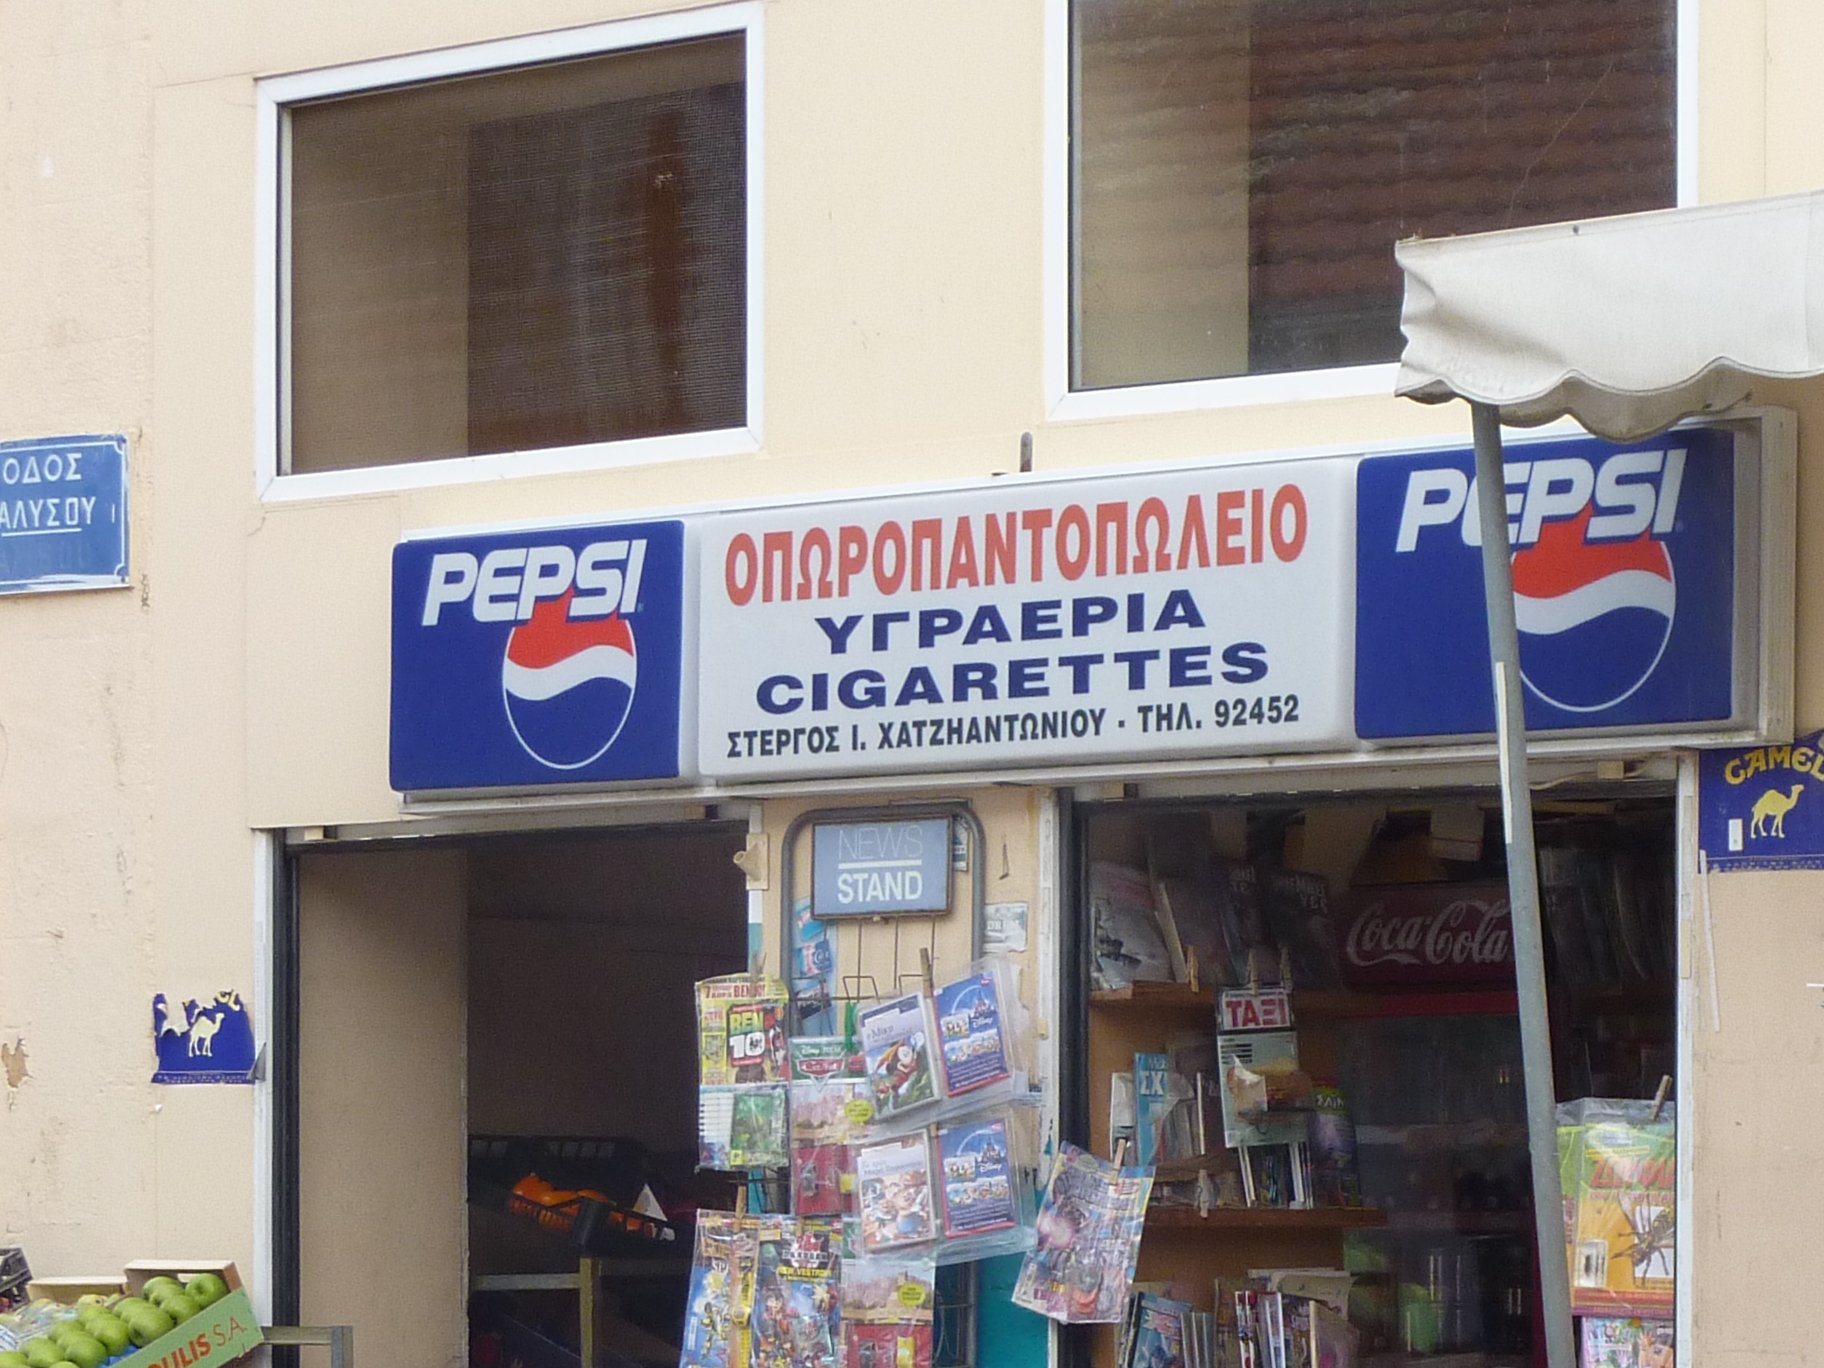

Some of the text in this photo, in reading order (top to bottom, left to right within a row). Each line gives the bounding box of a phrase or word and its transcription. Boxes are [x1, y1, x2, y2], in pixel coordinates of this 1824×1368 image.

[3, 452, 82, 485] ΟΔΟΣ
[1396, 448, 1687, 553] PEPSI
[725, 483, 1308, 606] ΟΠΩΡΟΠΑΝΤΟΠΩΛΕΙΟ
[422, 539, 647, 625] PEPSI
[815, 588, 1205, 654] ΥΓΡΑΕΡΙΑ
[757, 641, 1268, 715] CIGARETTES
[727, 725, 840, 757] ΣΤΕΡΓΟΣ
[878, 708, 1106, 749] ΧΑΤΖΗΑΝΤΩΝΙΟΥ
[1138, 701, 1202, 734] ΤΗΛ.
[1215, 694, 1299, 727] 92452
[838, 826, 923, 860] NEWS
[838, 871, 923, 903] STAND
[1348, 899, 1512, 967] Coca-Cola
[731, 1012, 764, 1030] BEN
[1225, 998, 1290, 1028] ΤΑΞΙ
[729, 1032, 766, 1058] 10
